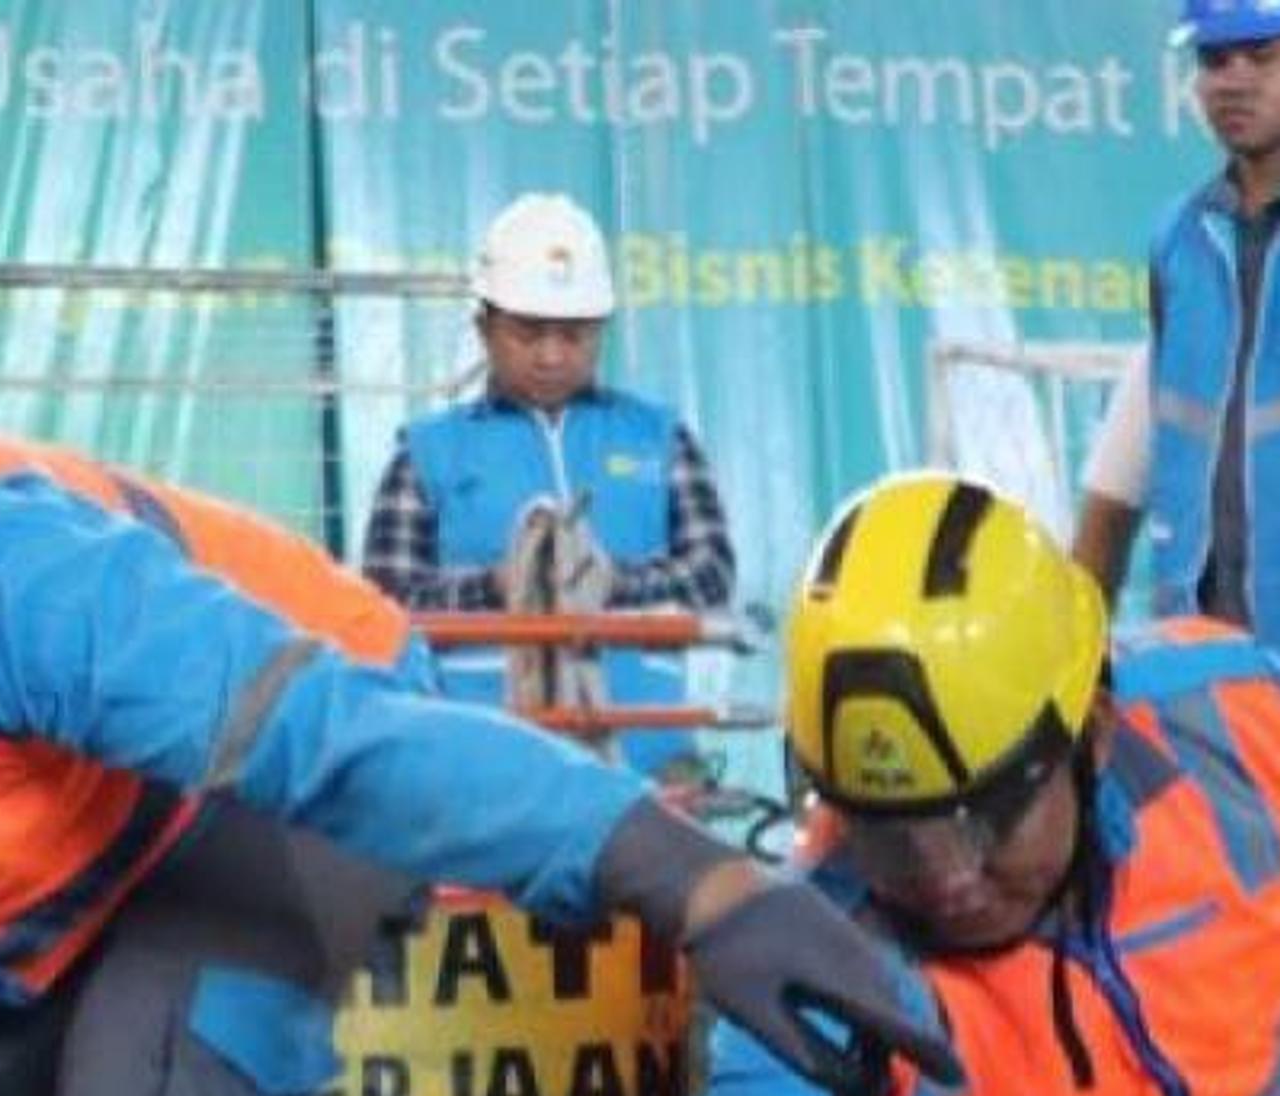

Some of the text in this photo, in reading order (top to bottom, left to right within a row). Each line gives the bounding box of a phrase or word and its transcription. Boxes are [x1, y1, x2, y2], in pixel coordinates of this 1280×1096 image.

[314, 24, 401, 120] di
[434, 26, 754, 145] Setiap
[773, 27, 1134, 148] Tempat
[625, 228, 842, 309] Bisnis
